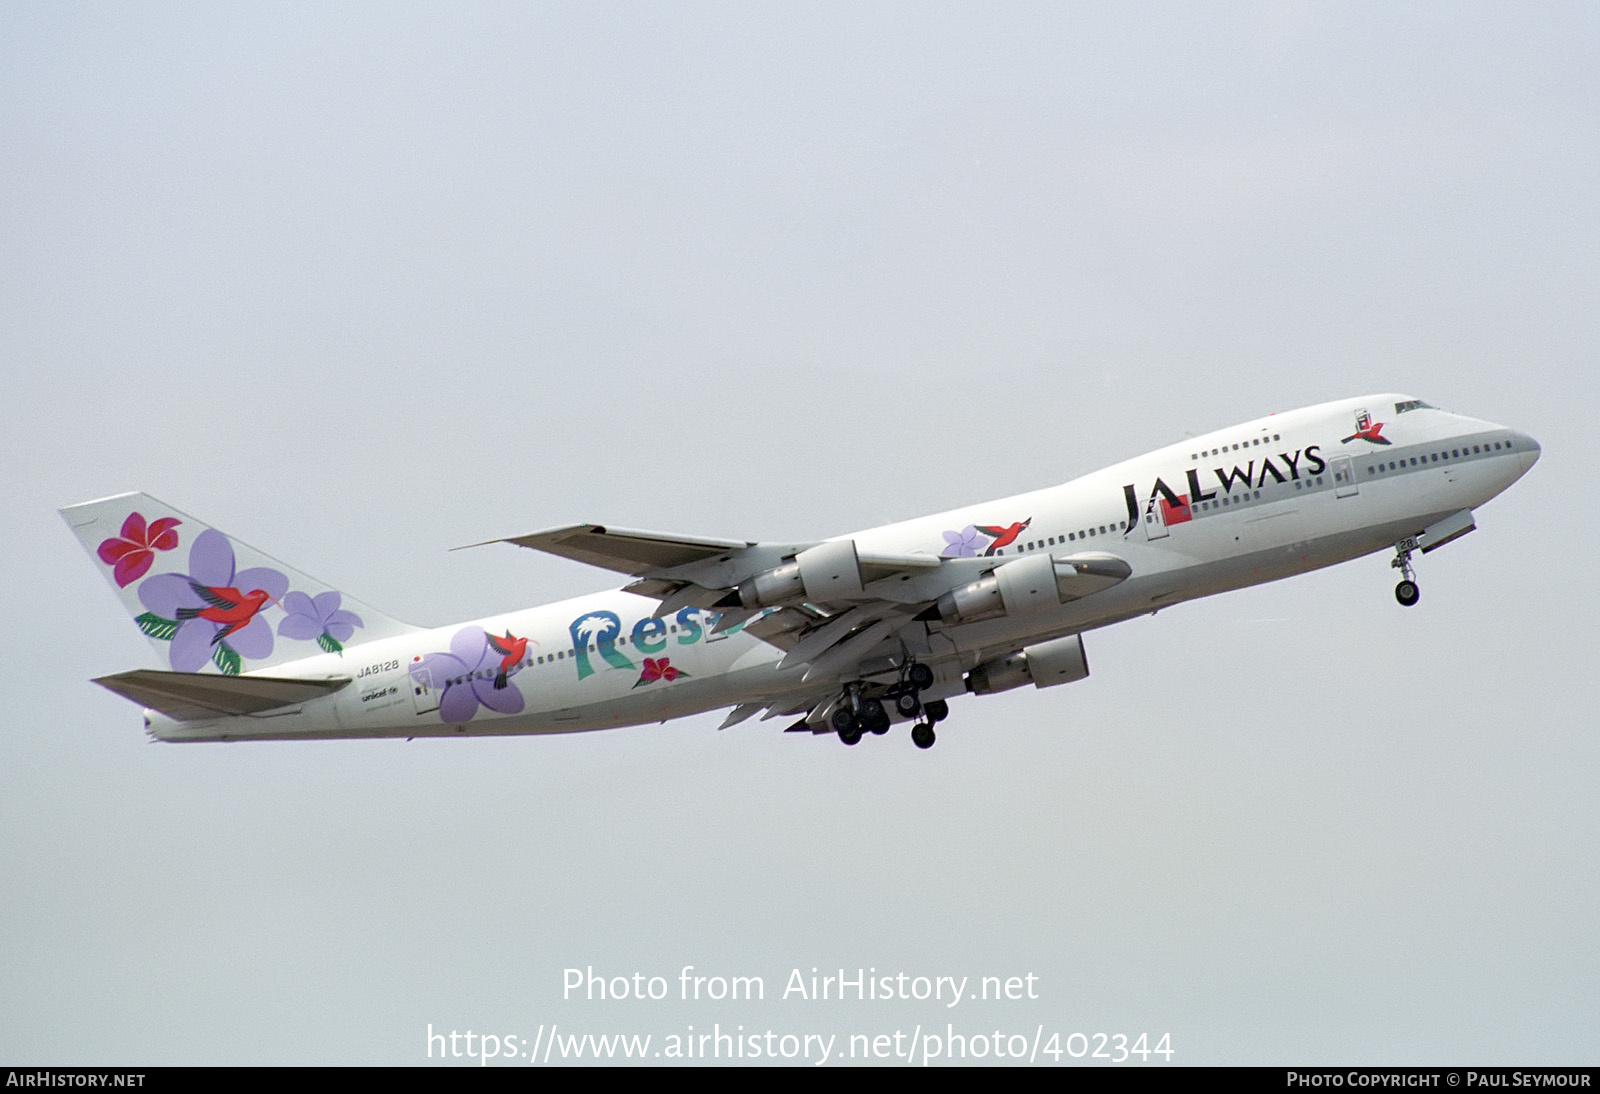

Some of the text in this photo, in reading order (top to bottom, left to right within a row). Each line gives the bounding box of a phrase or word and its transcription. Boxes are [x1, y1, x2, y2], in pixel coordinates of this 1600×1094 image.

[1122, 445, 1326, 536] JALWAYS
[1400, 538, 1414, 549] 28
[569, 606, 747, 681] Res
[357, 659, 400, 678] JA8128
[361, 687, 387, 702] unicef
